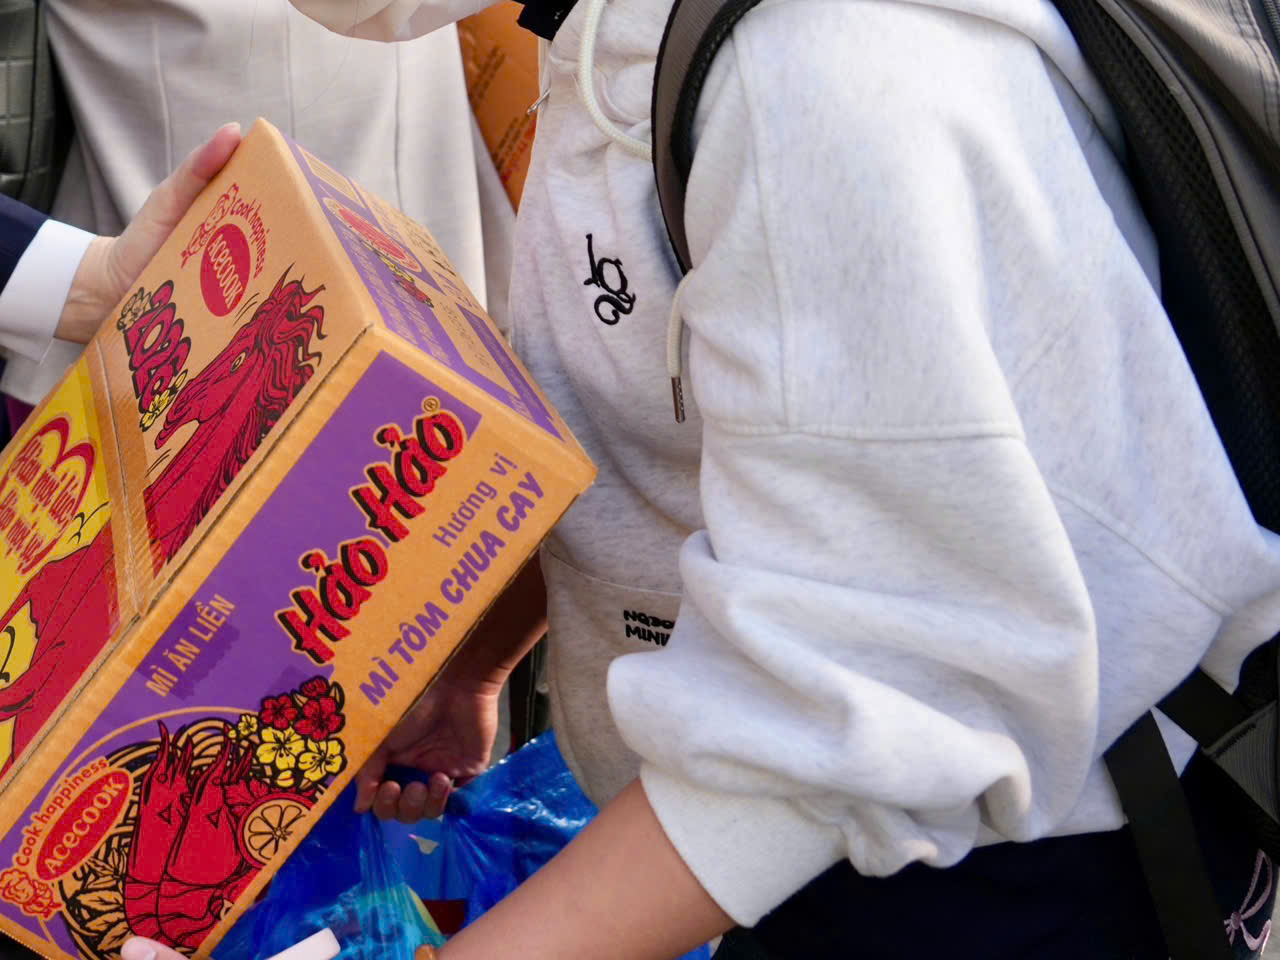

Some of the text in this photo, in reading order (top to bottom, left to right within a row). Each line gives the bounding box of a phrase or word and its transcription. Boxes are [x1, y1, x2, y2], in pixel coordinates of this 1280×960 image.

[122, 280, 192, 414] 2026
[277, 539, 389, 664] Hảo
[352, 411, 464, 542] Hảo
[432, 452, 519, 548] Hương vị
[145, 593, 236, 697] MÌ ĂN LIỀN
[359, 656, 399, 706] MÌ
[388, 601, 449, 665] TÔM
[440, 530, 505, 604] CHUA
[496, 471, 545, 532] CAY
[34, 758, 109, 825] happiness
